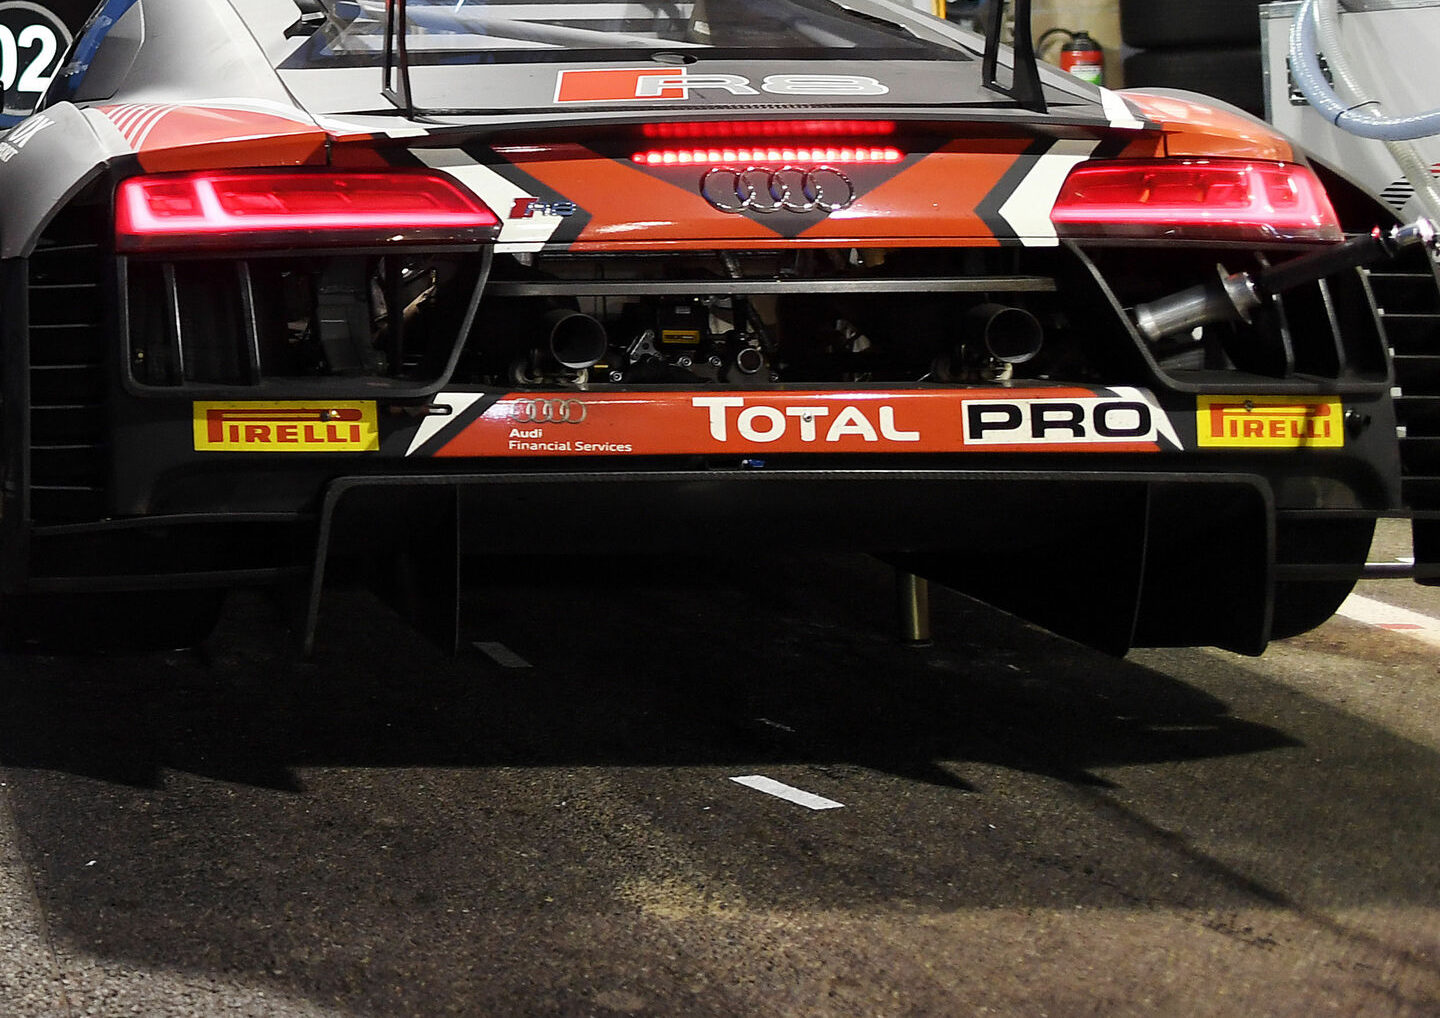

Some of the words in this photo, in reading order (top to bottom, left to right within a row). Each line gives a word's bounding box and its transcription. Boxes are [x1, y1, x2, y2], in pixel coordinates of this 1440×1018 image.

[634, 74, 890, 96] R8
[206, 408, 363, 444] PIRELLI
[509, 429, 544, 439] Audi
[967, 401, 1154, 440] PRO
[1210, 402, 1333, 439] PIRELLI
[508, 441, 573, 451] Financial
[574, 442, 633, 452] Services
